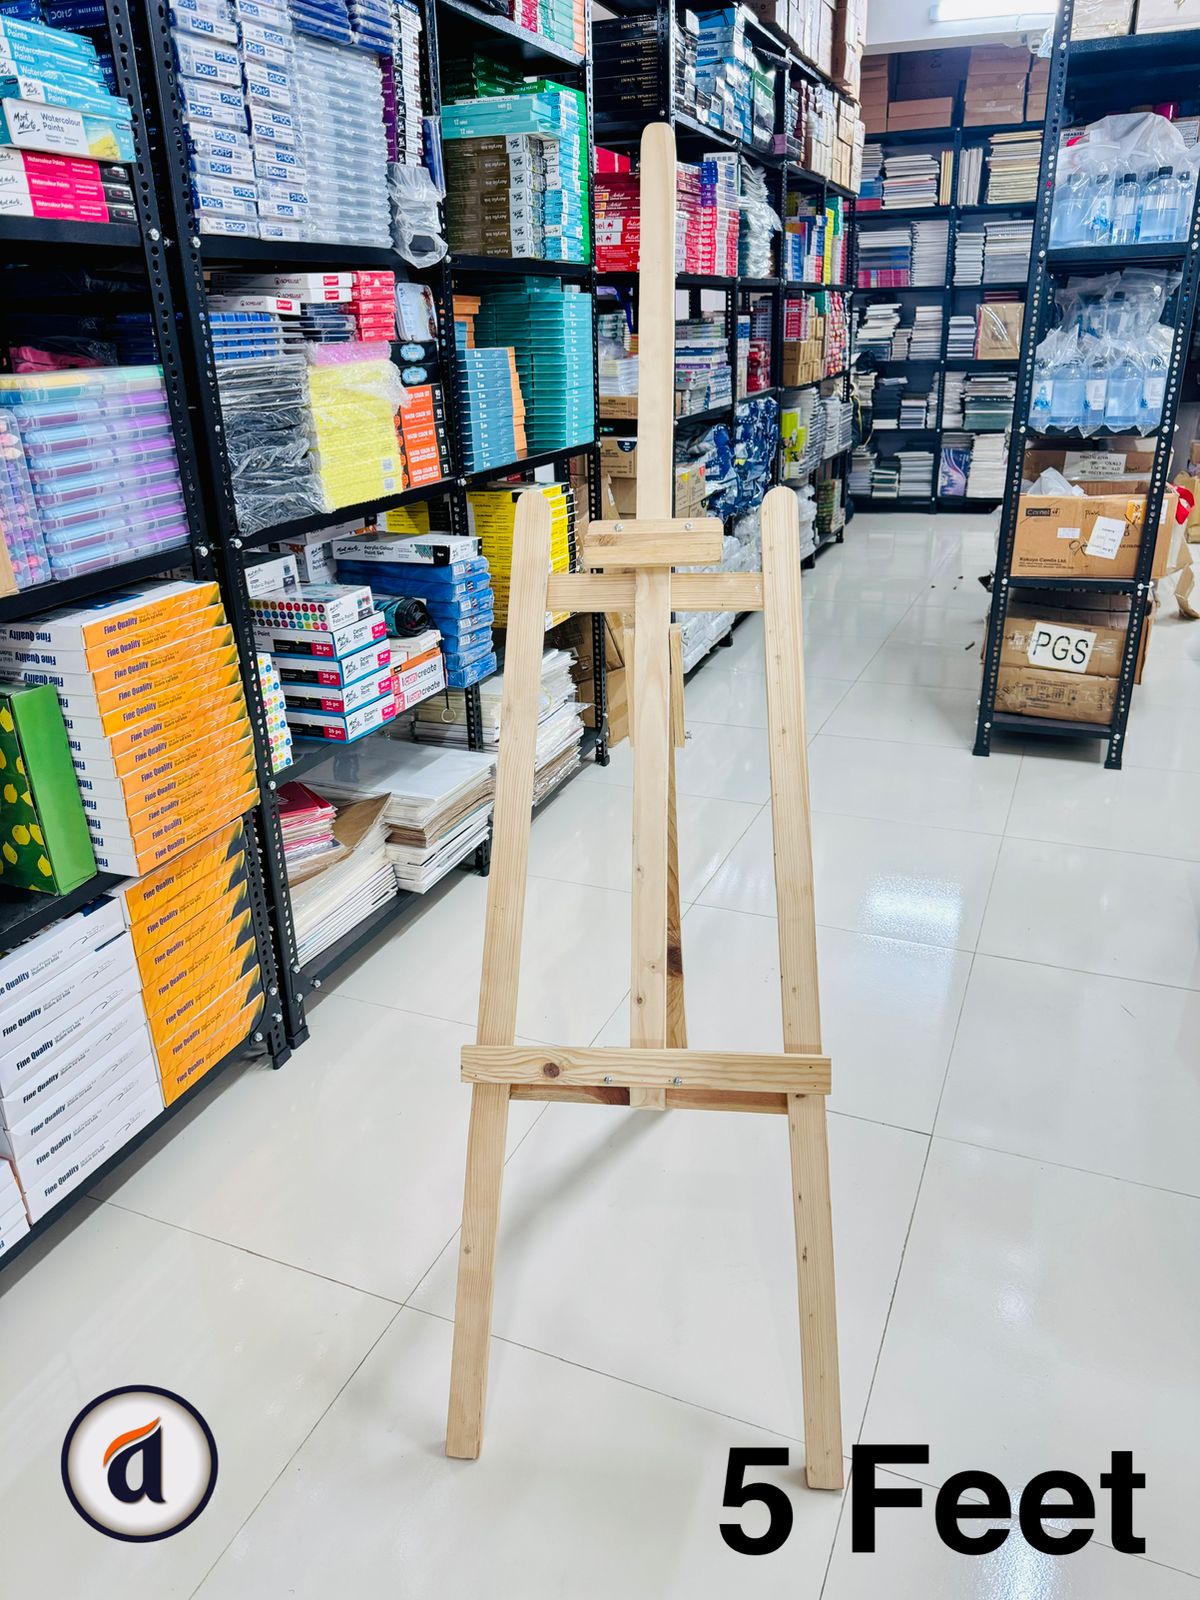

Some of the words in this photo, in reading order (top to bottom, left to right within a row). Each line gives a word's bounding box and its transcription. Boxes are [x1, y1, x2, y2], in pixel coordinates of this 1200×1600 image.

[2, 6, 19, 14] TUBES
[50, 8, 73, 20] DOMS
[13, 111, 29, 122] Mont
[40, 113, 81, 127] Watercolour
[42, 121, 65, 133] Paints
[1027, 508, 1050, 516] Camel
[9, 630, 34, 641] Quality
[104, 625, 116, 634] Fine
[117, 617, 137, 630] Quality
[36, 632, 51, 642] Fine
[15, 652, 40, 664] Quality
[107, 648, 119, 658] Fine
[120, 640, 140, 653] Quality
[1032, 631, 1089, 665] PGS
[41, 655, 56, 665] Fine
[114, 669, 127, 679] Fine
[128, 661, 148, 674] Quality
[23, 673, 48, 685] Quality
[417, 663, 437, 678] create
[119, 691, 131, 701] Fine
[132, 682, 152, 695] Quality
[422, 680, 441, 695] create
[123, 711, 135, 722] Fine
[136, 703, 156, 716] Quality
[131, 732, 142, 742] Fine
[143, 723, 162, 736] Quality
[135, 752, 147, 762] Fine
[148, 742, 167, 756] Quality
[141, 772, 153, 782] Fine
[154, 762, 172, 776] Quality
[145, 792, 156, 802] Fine
[157, 781, 176, 796] Quality
[149, 810, 159, 820] Fine
[161, 800, 179, 814] Quality
[152, 829, 163, 839] Fine
[164, 818, 182, 833] Quality
[155, 848, 167, 859] Fine
[167, 837, 185, 852] Quality
[143, 889, 155, 901] Fine
[155, 876, 174, 892] Quality
[147, 922, 159, 934] Fine
[159, 909, 178, 925] Quality
[154, 953, 166, 965] Fine
[166, 940, 184, 956] Quality
[6, 971, 30, 991] Quality
[158, 984, 169, 995] Fine
[169, 970, 187, 986] Quality
[166, 1013, 177, 1025] Fine
[176, 999, 194, 1016] Quality
[2, 1023, 18, 1038] Fine
[18, 1007, 42, 1027] Quality
[172, 1043, 183, 1055] Fine
[183, 1028, 200, 1046] Quality
[16, 1056, 31, 1071] Fine
[31, 1040, 54, 1060] Quality
[176, 1072, 188, 1084] Fine
[187, 1057, 205, 1075] Quality
[23, 1090, 37, 1104] Fine
[37, 1072, 59, 1093] Quality
[30, 1122, 44, 1136] Fine
[44, 1104, 66, 1125] Quality
[36, 1151, 50, 1165] Fine
[50, 1133, 72, 1154] Quality
[44, 1183, 58, 1197] Fine
[57, 1164, 79, 1185] Quality
